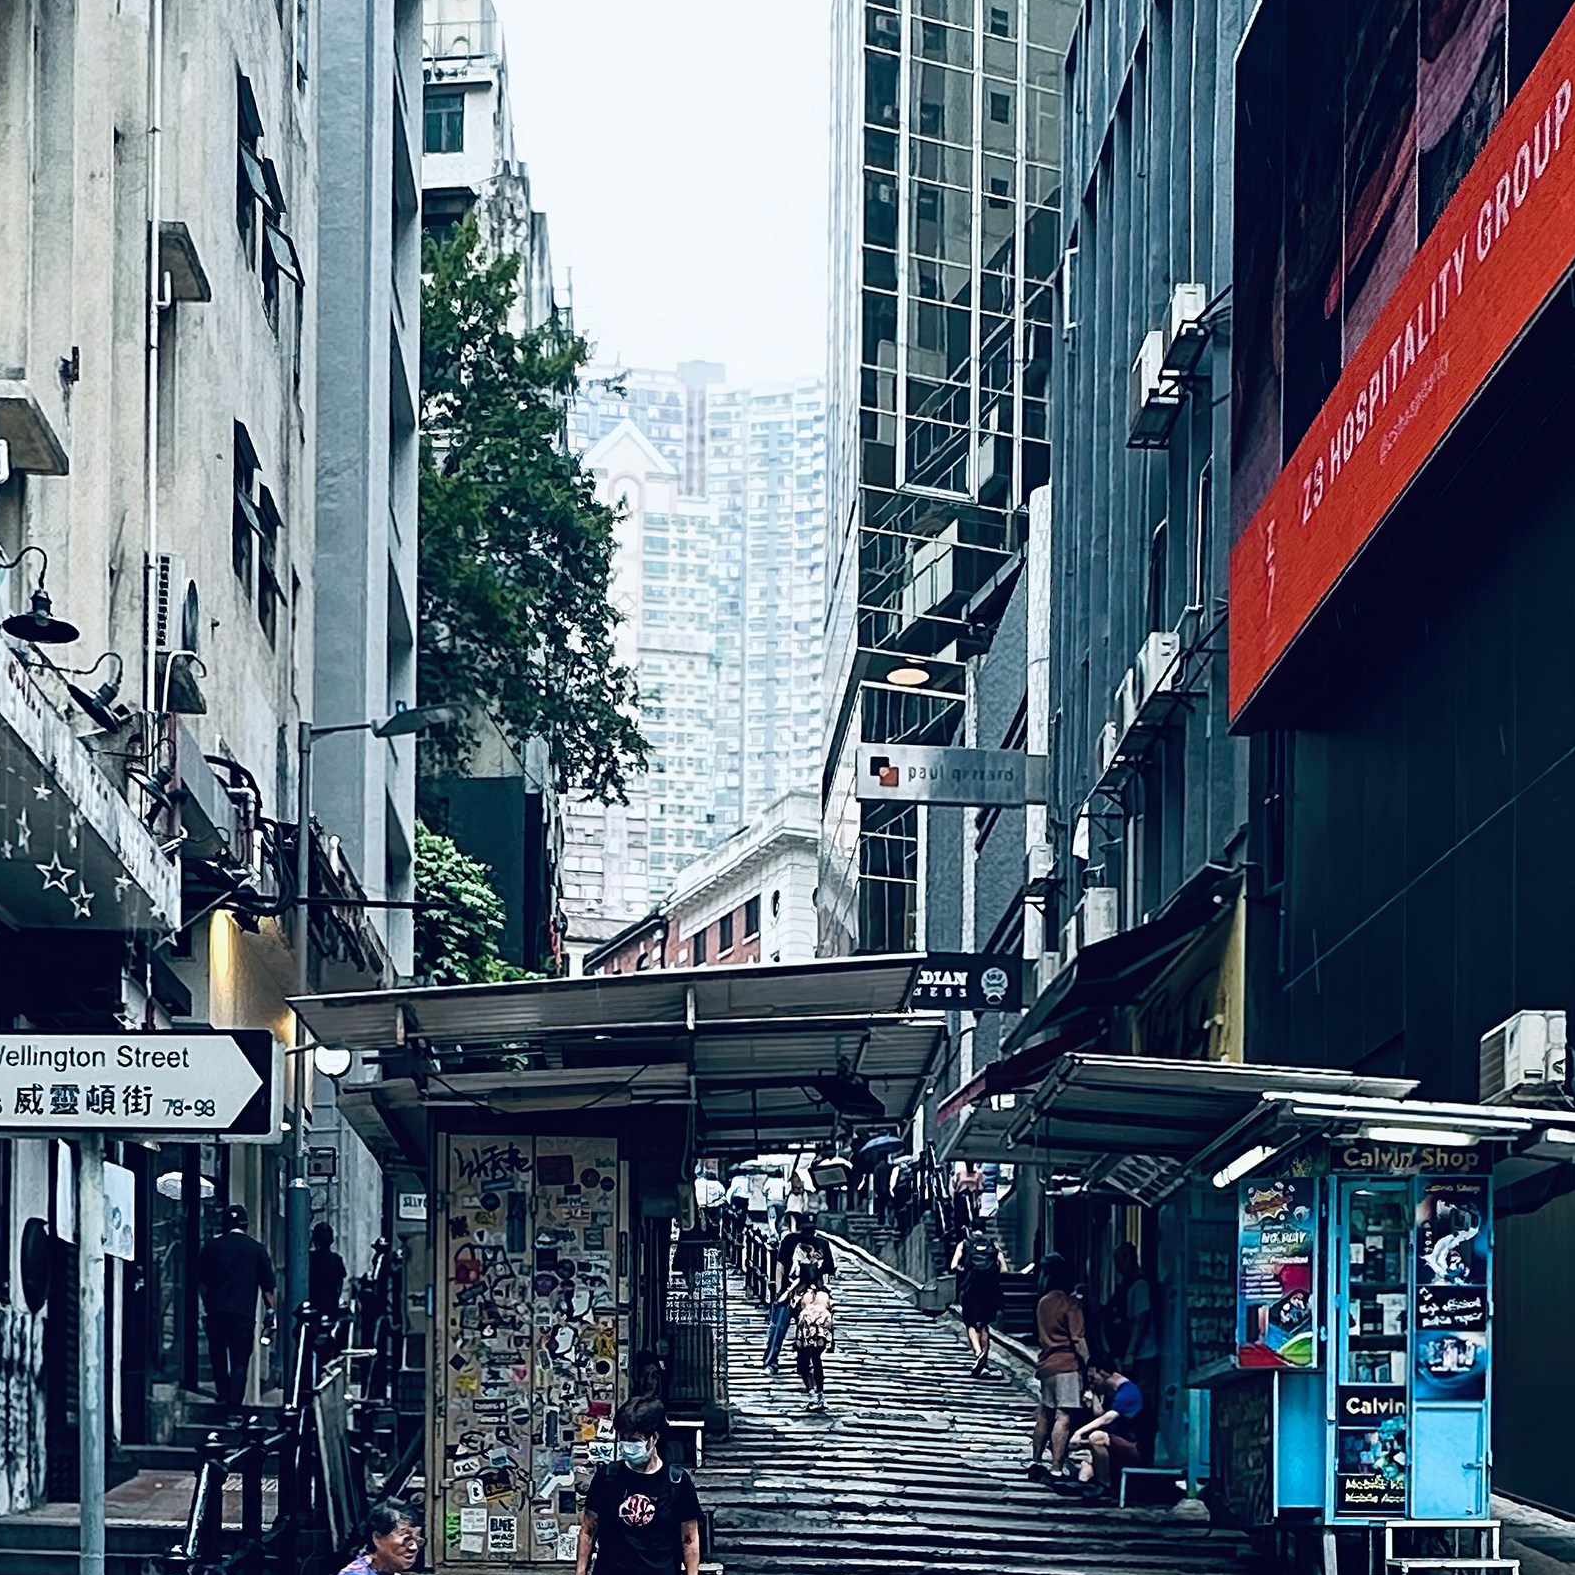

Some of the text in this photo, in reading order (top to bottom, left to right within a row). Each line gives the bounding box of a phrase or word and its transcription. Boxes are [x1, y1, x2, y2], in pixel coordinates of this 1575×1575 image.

[1330, 232, 1467, 485] HOSPITALITY
[1476, 78, 1572, 263] GROUP
[908, 764, 944, 783] paul
[917, 970, 968, 986] DIAN
[116, 1044, 190, 1068] Street
[14, 1083, 153, 1116] 威靈頓街
[1343, 1147, 1480, 1169] Calvin Shop
[1345, 1397, 1406, 1415] Calvin
